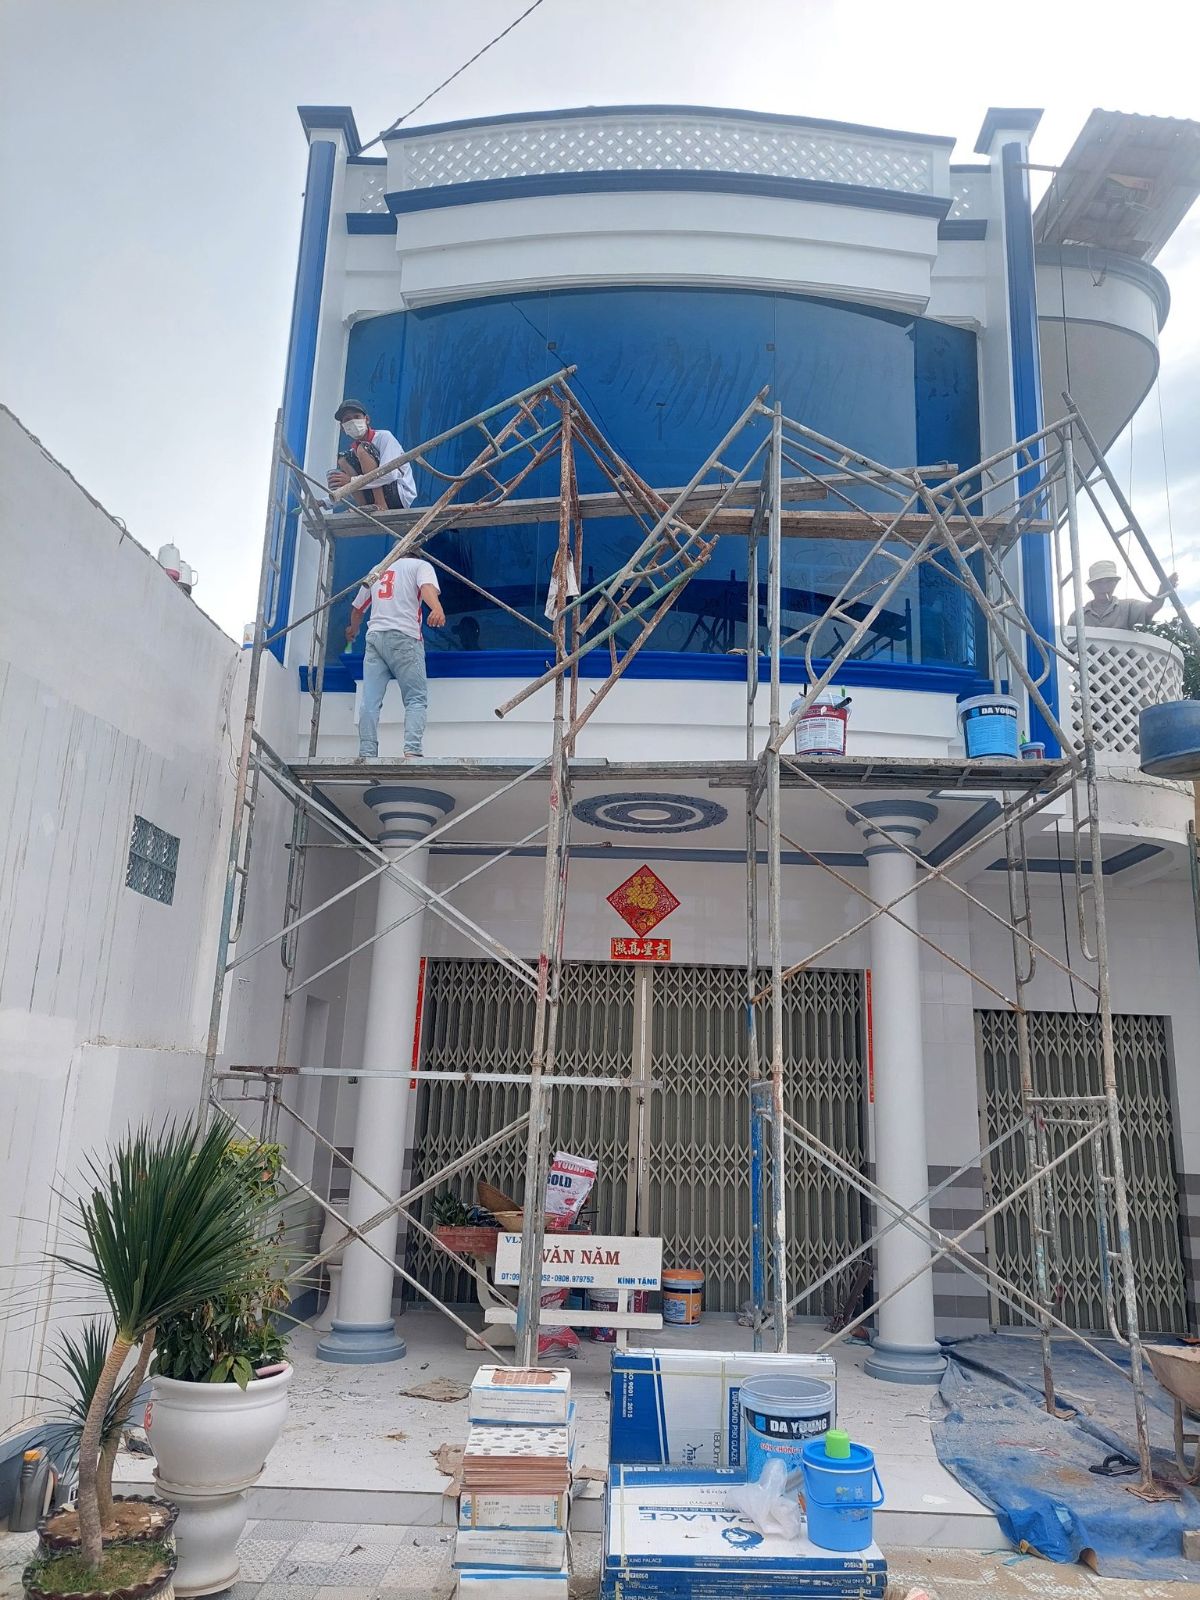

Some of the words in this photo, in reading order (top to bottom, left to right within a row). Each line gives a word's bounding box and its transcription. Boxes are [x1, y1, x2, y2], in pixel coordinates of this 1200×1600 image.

[378, 570, 395, 600] 3
[981, 707, 993, 715] DA
[580, 1246, 620, 1266] NĂM
[770, 1420, 788, 1433] DA
[640, 1513, 754, 1524] PALACE
